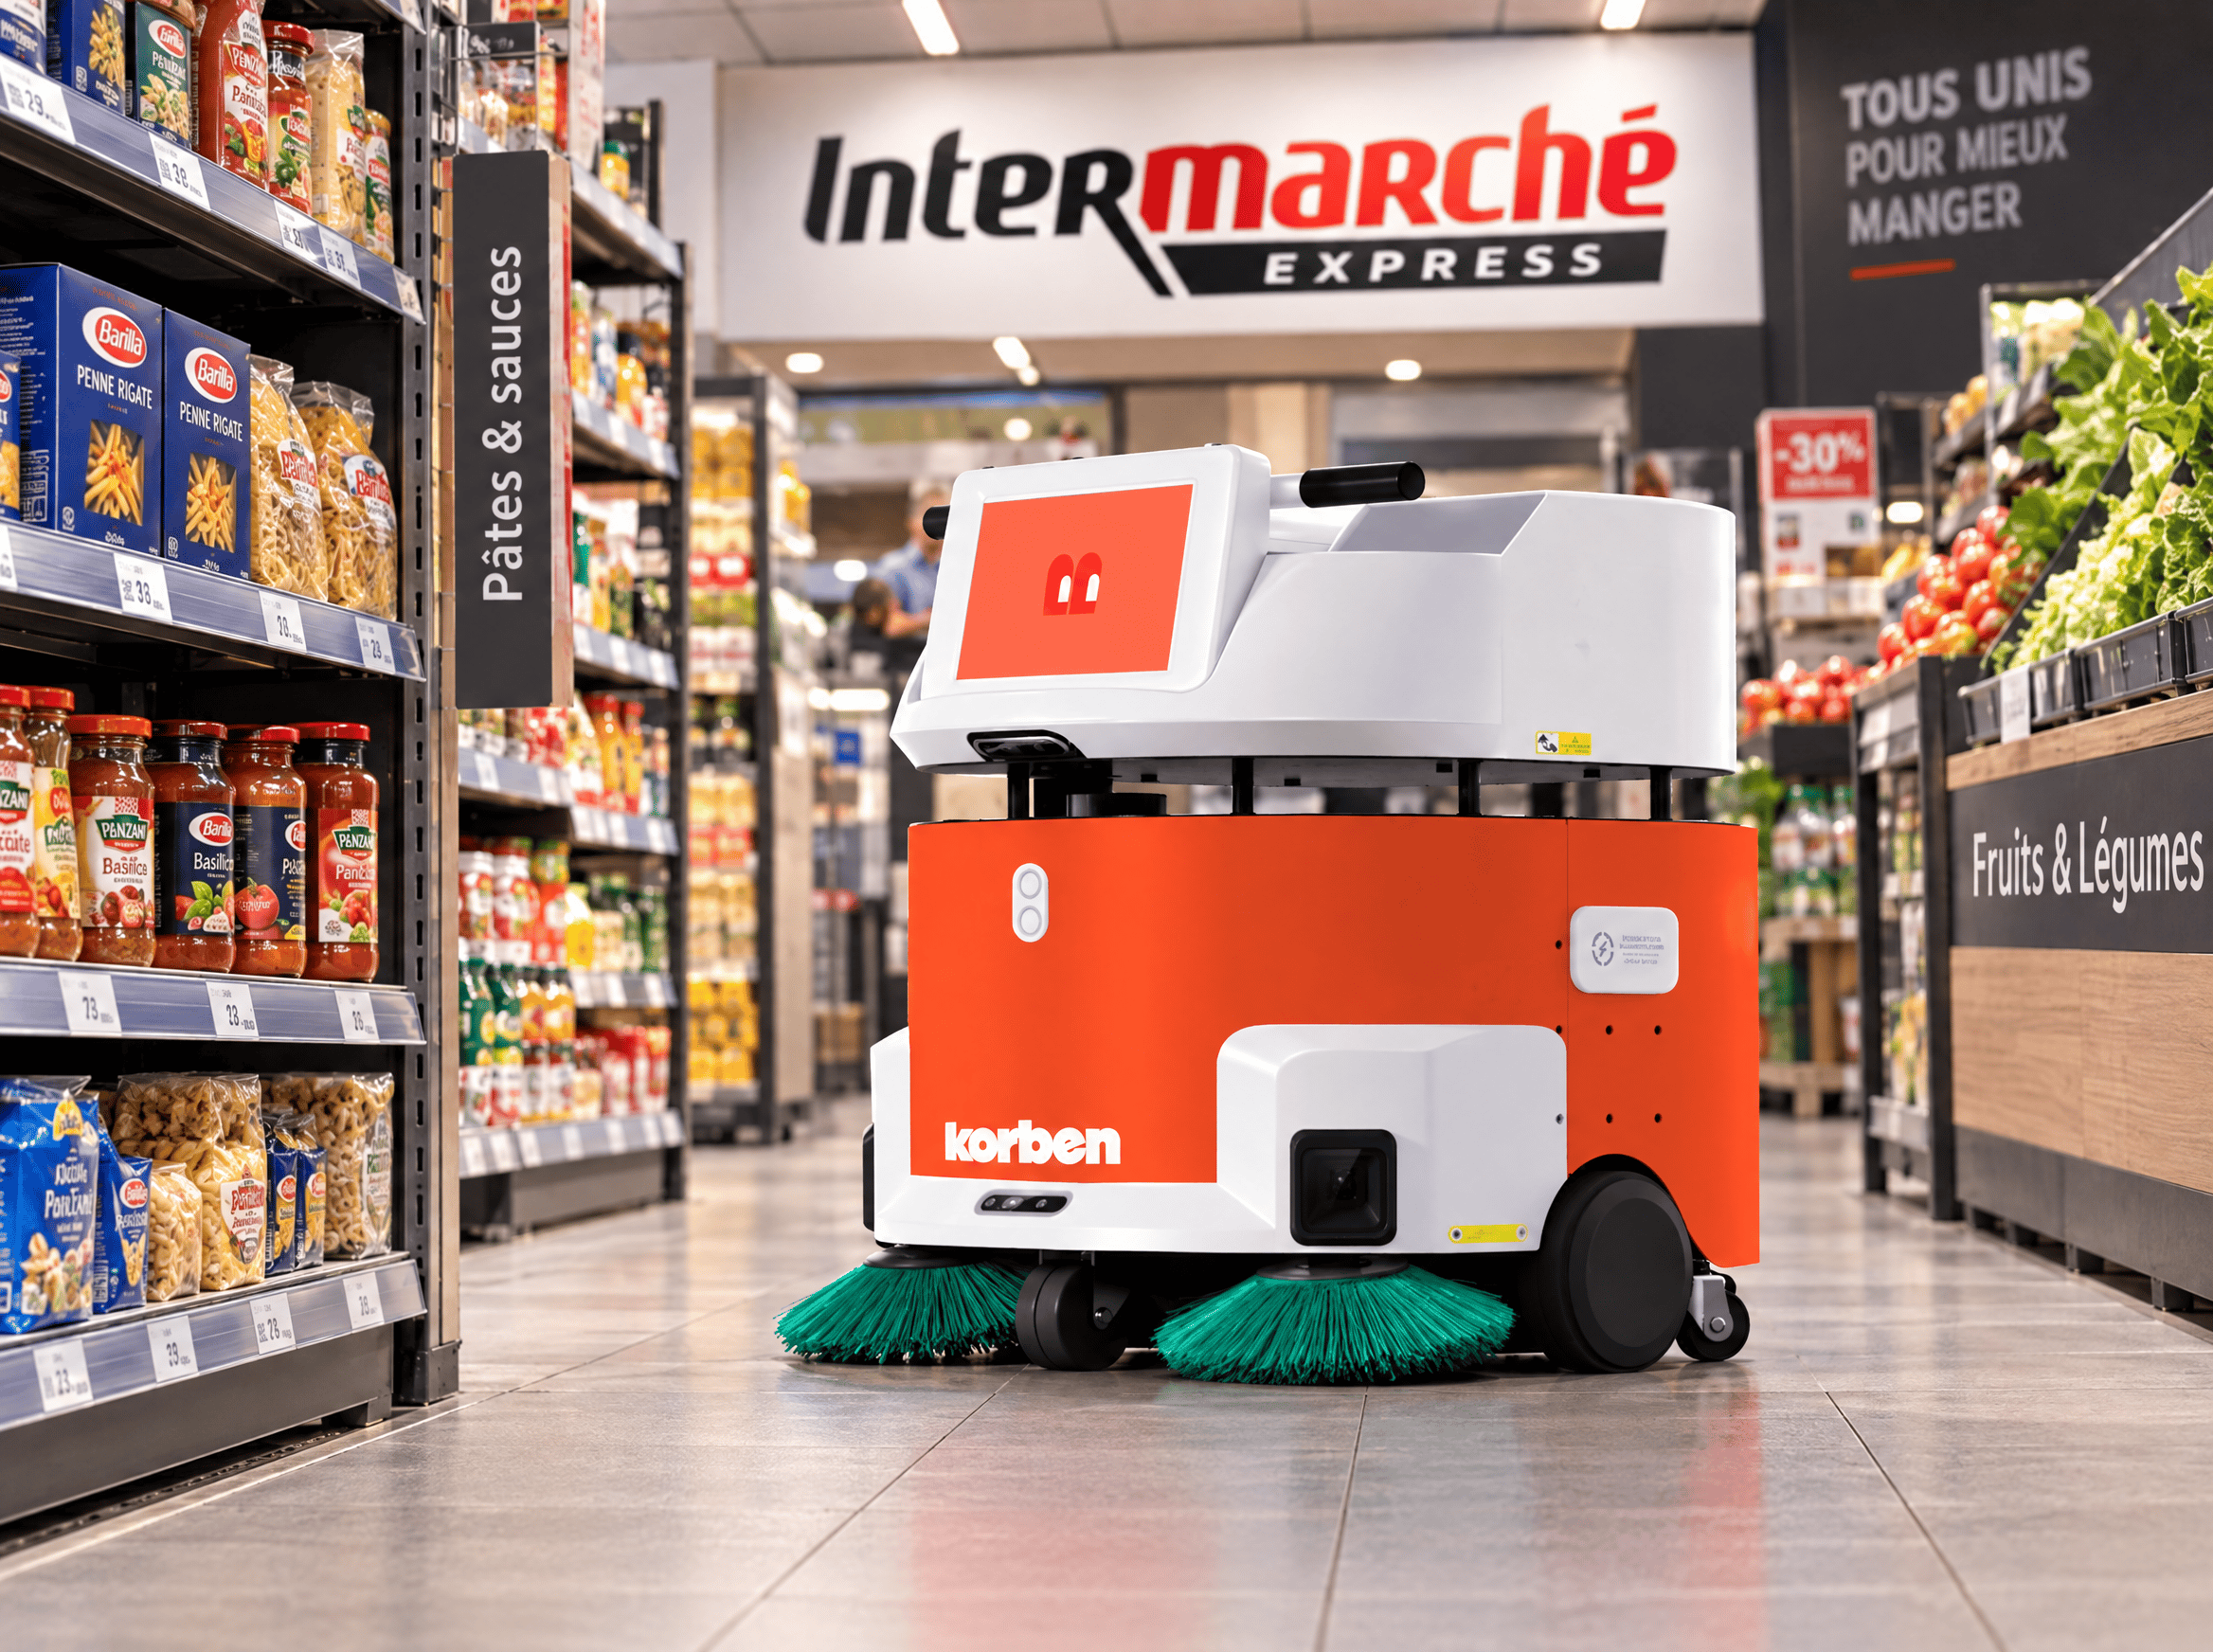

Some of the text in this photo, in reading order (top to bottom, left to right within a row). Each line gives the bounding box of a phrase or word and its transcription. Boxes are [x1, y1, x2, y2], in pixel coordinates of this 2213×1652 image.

[1840, 45, 2093, 132] TOUS UNIS
[1846, 112, 2069, 189] POUR MIEUX
[1848, 180, 2023, 246] MANGER
[1264, 242, 1603, 285] EXPRESS
[99, 318, 143, 357] Barilla
[77, 364, 153, 410] PENNE RIGATE
[197, 357, 235, 393] Barilla
[179, 401, 244, 442] PENNE RIGATE
[481, 245, 523, 601] Pâtes & sauces
[1774, 431, 1865, 474] -30%
[1972, 816, 2205, 914] Fruits & Légumes
[945, 1119, 1122, 1165] korben
